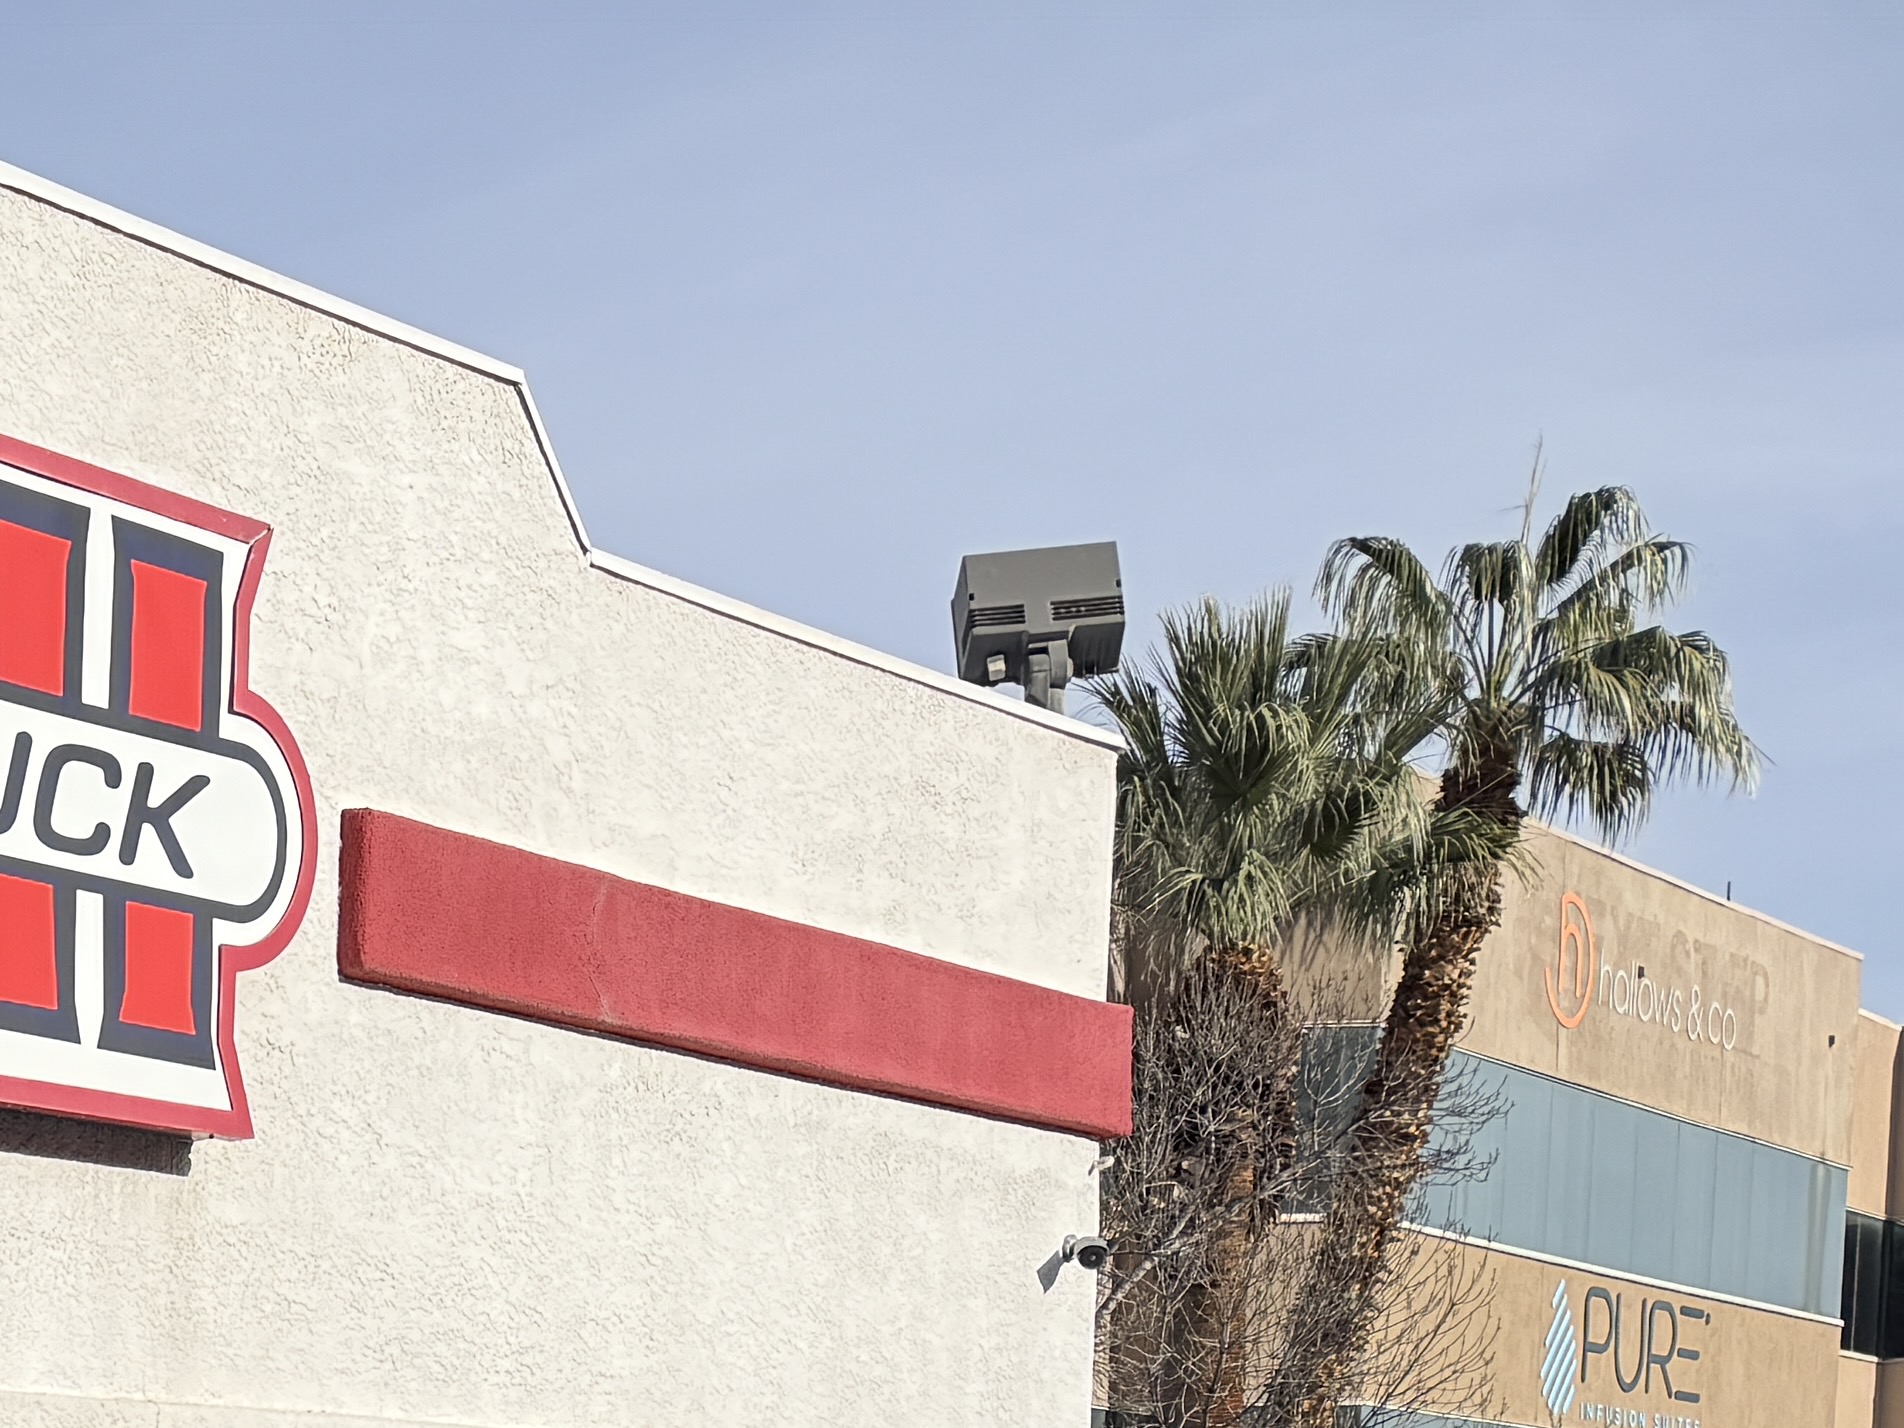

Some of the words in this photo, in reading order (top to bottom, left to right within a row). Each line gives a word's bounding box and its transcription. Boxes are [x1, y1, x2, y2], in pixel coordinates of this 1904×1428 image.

[1598, 947, 1683, 1033] hallows
[1687, 983, 1704, 1042] &
[1708, 1001, 1737, 1051] co
[1581, 1286, 1705, 1404] PURE
